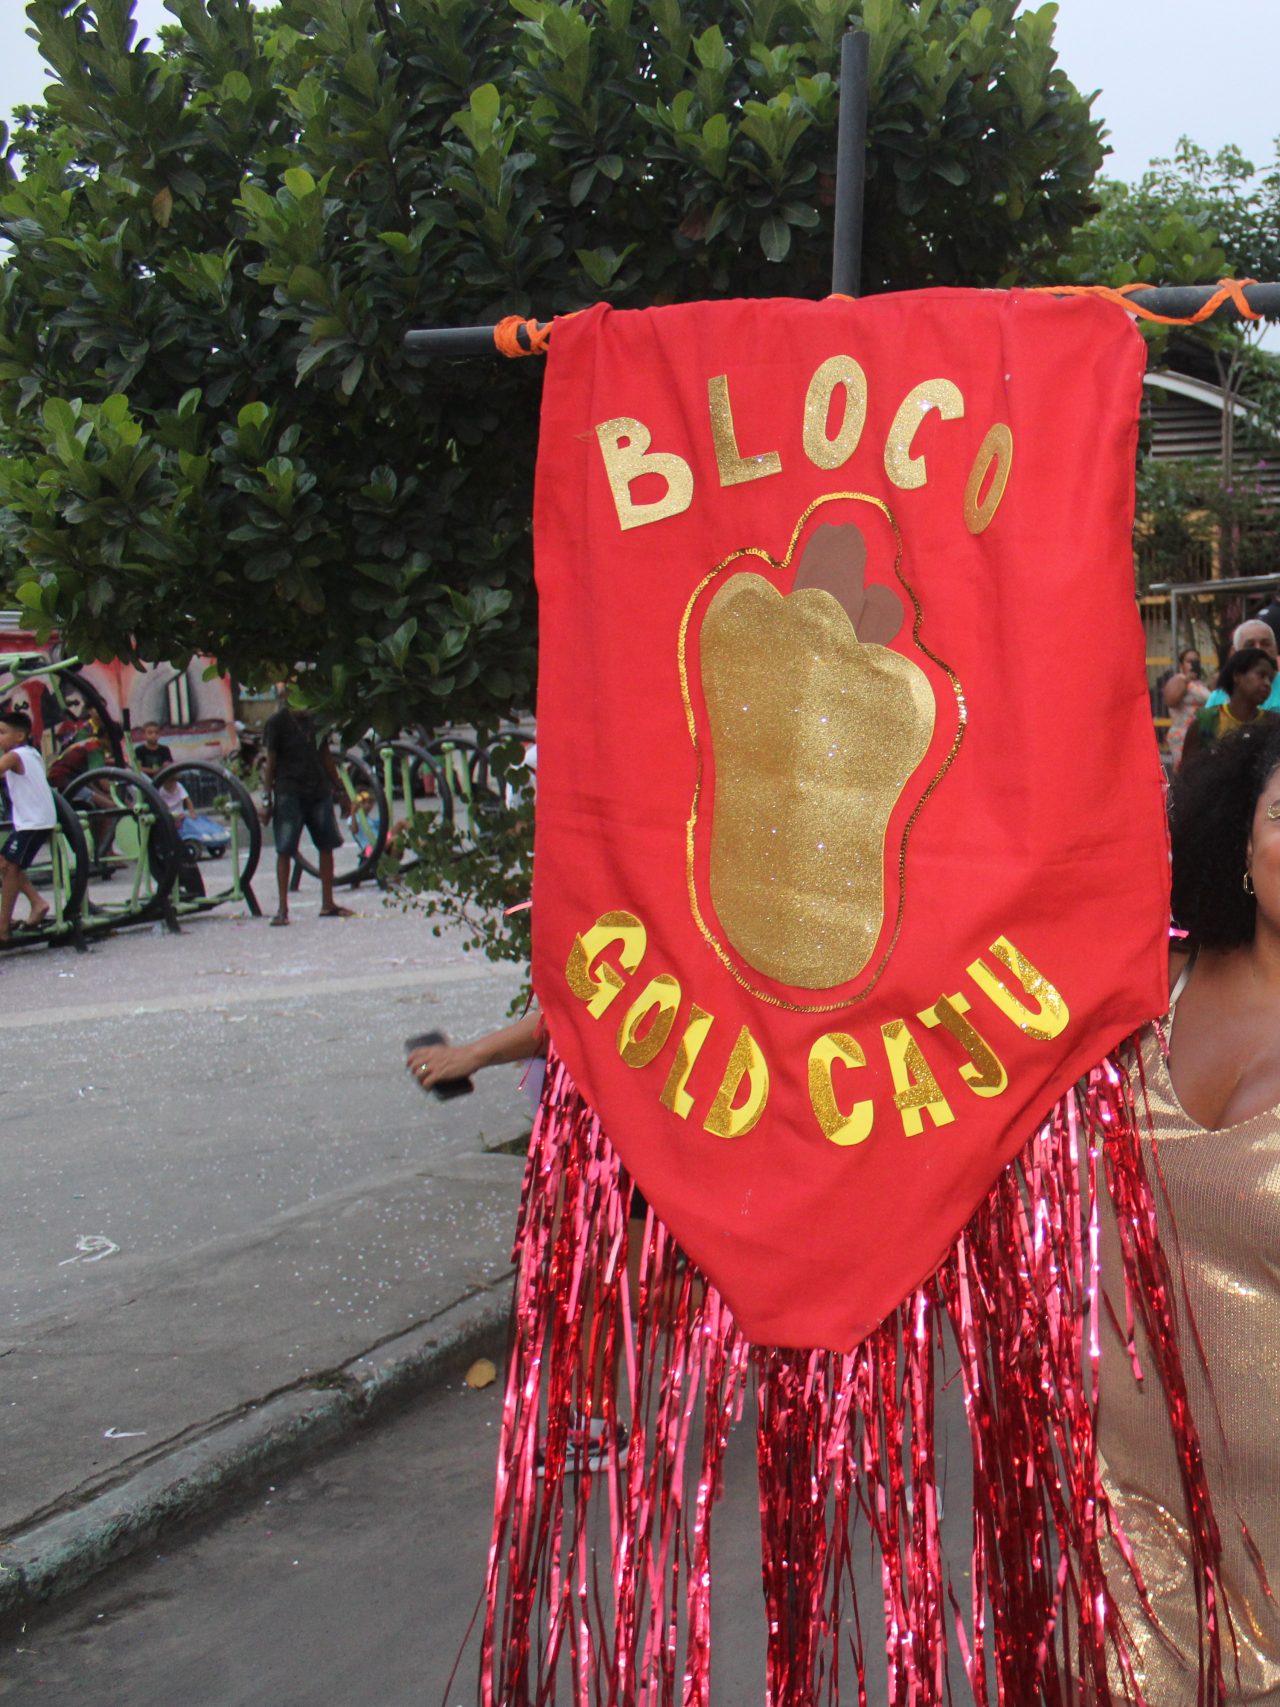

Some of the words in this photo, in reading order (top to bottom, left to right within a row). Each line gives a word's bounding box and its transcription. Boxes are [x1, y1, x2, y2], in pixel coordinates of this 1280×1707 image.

[594, 354, 1013, 535] BLOCO
[565, 909, 769, 1139] GOLD
[809, 935, 1070, 1146] CAJU
